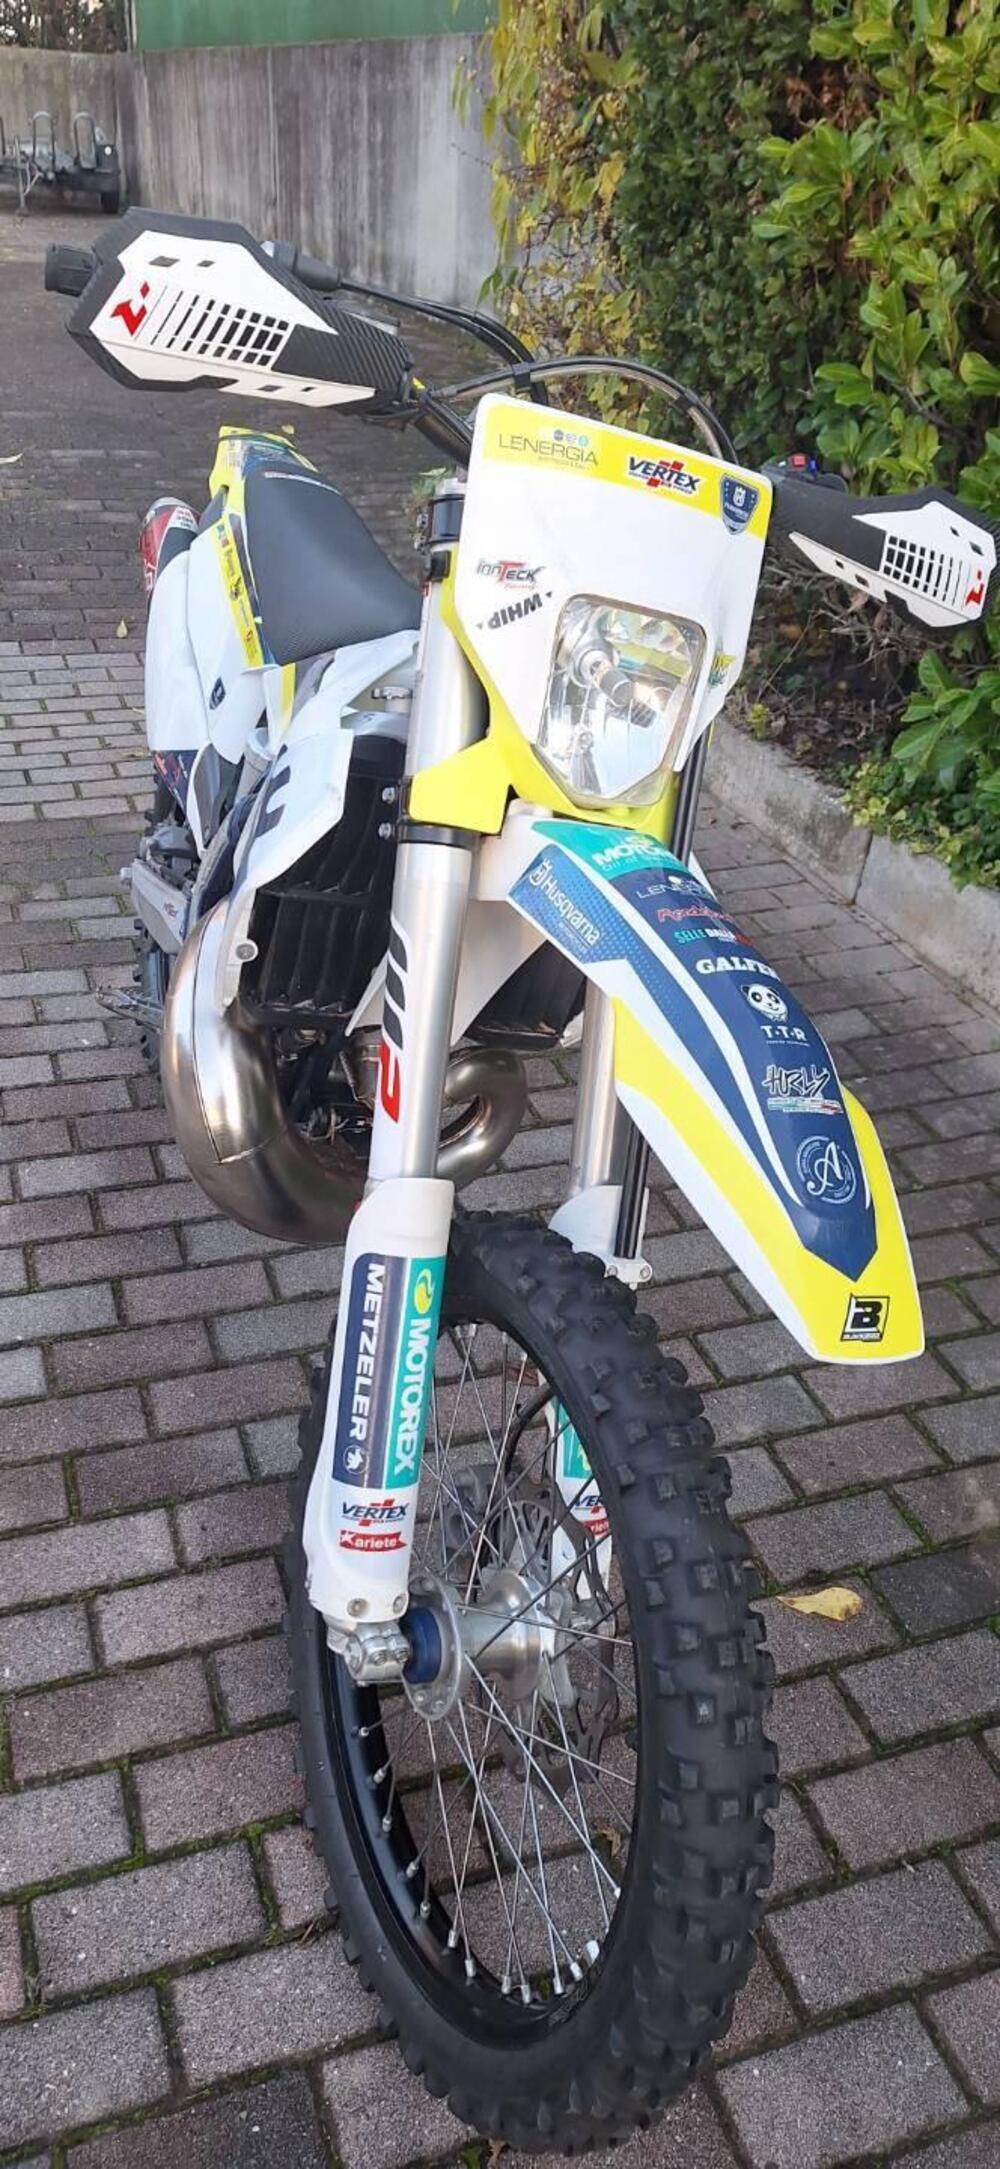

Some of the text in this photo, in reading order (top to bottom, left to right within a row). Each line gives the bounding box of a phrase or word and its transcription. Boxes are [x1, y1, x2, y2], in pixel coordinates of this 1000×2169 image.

[498, 432, 599, 467] LENERGIA
[628, 456, 700, 492] VERTEX
[488, 593, 543, 629] WHIP
[540, 874, 600, 946] Husqvarna
[350, 1263, 386, 1442] METZELER
[394, 1318, 432, 1476] MOTOREX
[342, 1501, 410, 1520] VERTEX
